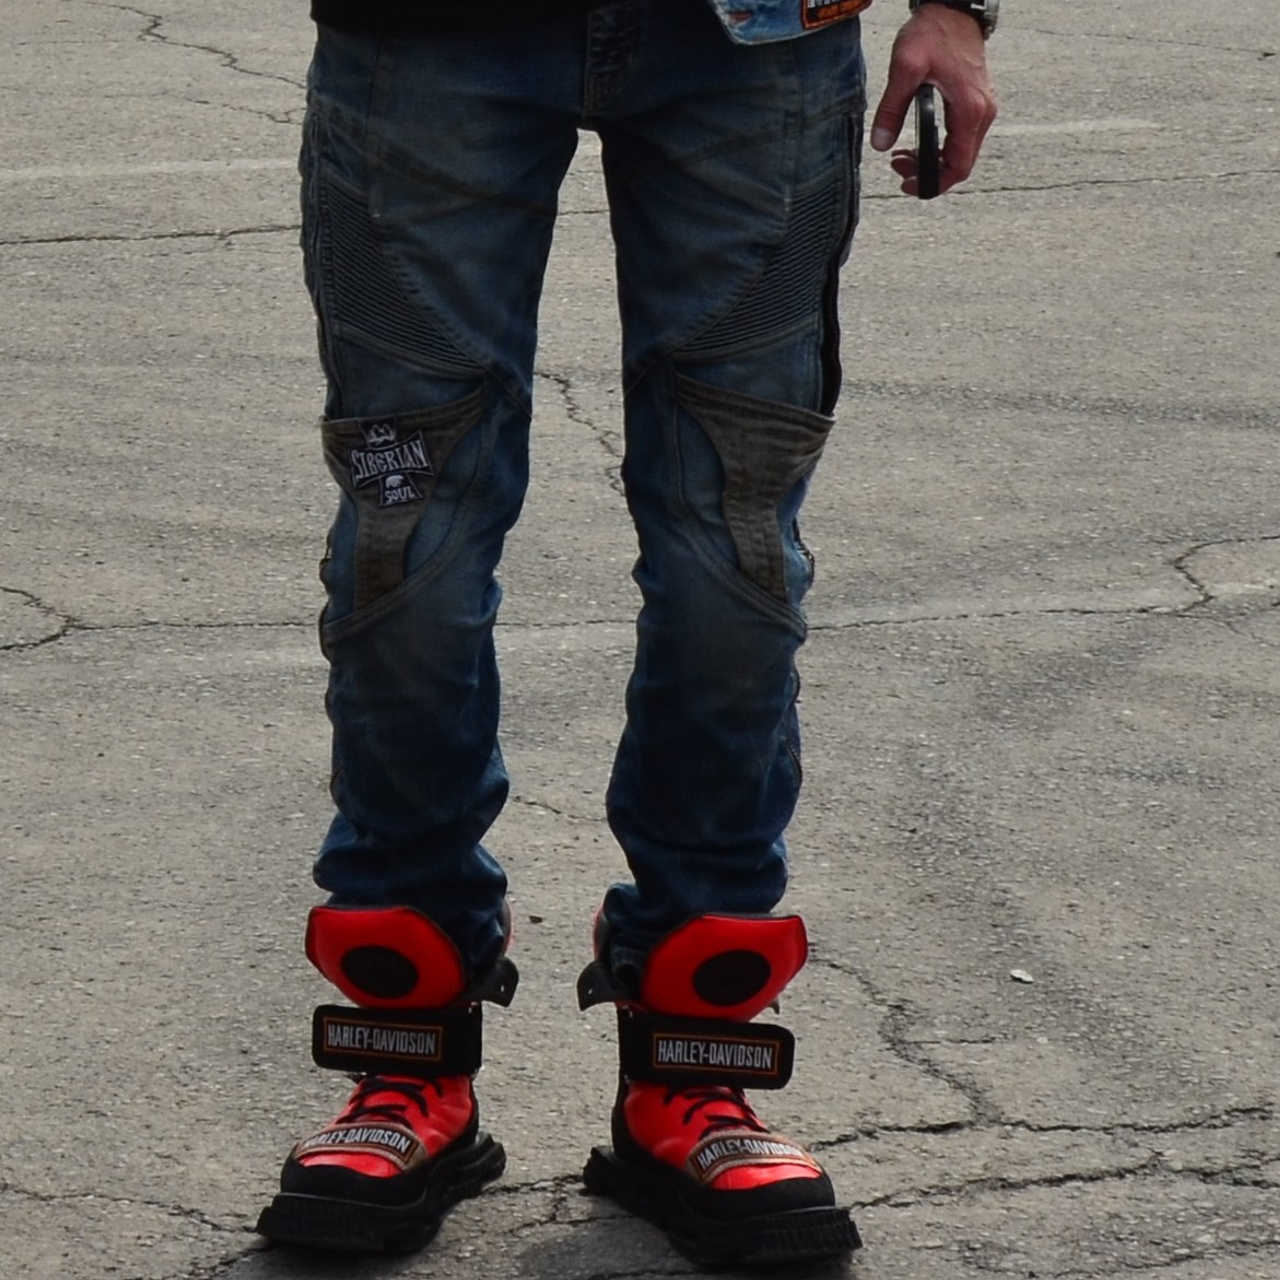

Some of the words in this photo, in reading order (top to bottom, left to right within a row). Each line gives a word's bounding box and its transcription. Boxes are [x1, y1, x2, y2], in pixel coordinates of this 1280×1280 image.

[350, 439, 429, 482] SIBERIAN
[384, 485, 416, 504] SOUL
[327, 1022, 437, 1056] HARLEY-DAVIDSON
[657, 1038, 773, 1070] HARLEY-DAVIDSON
